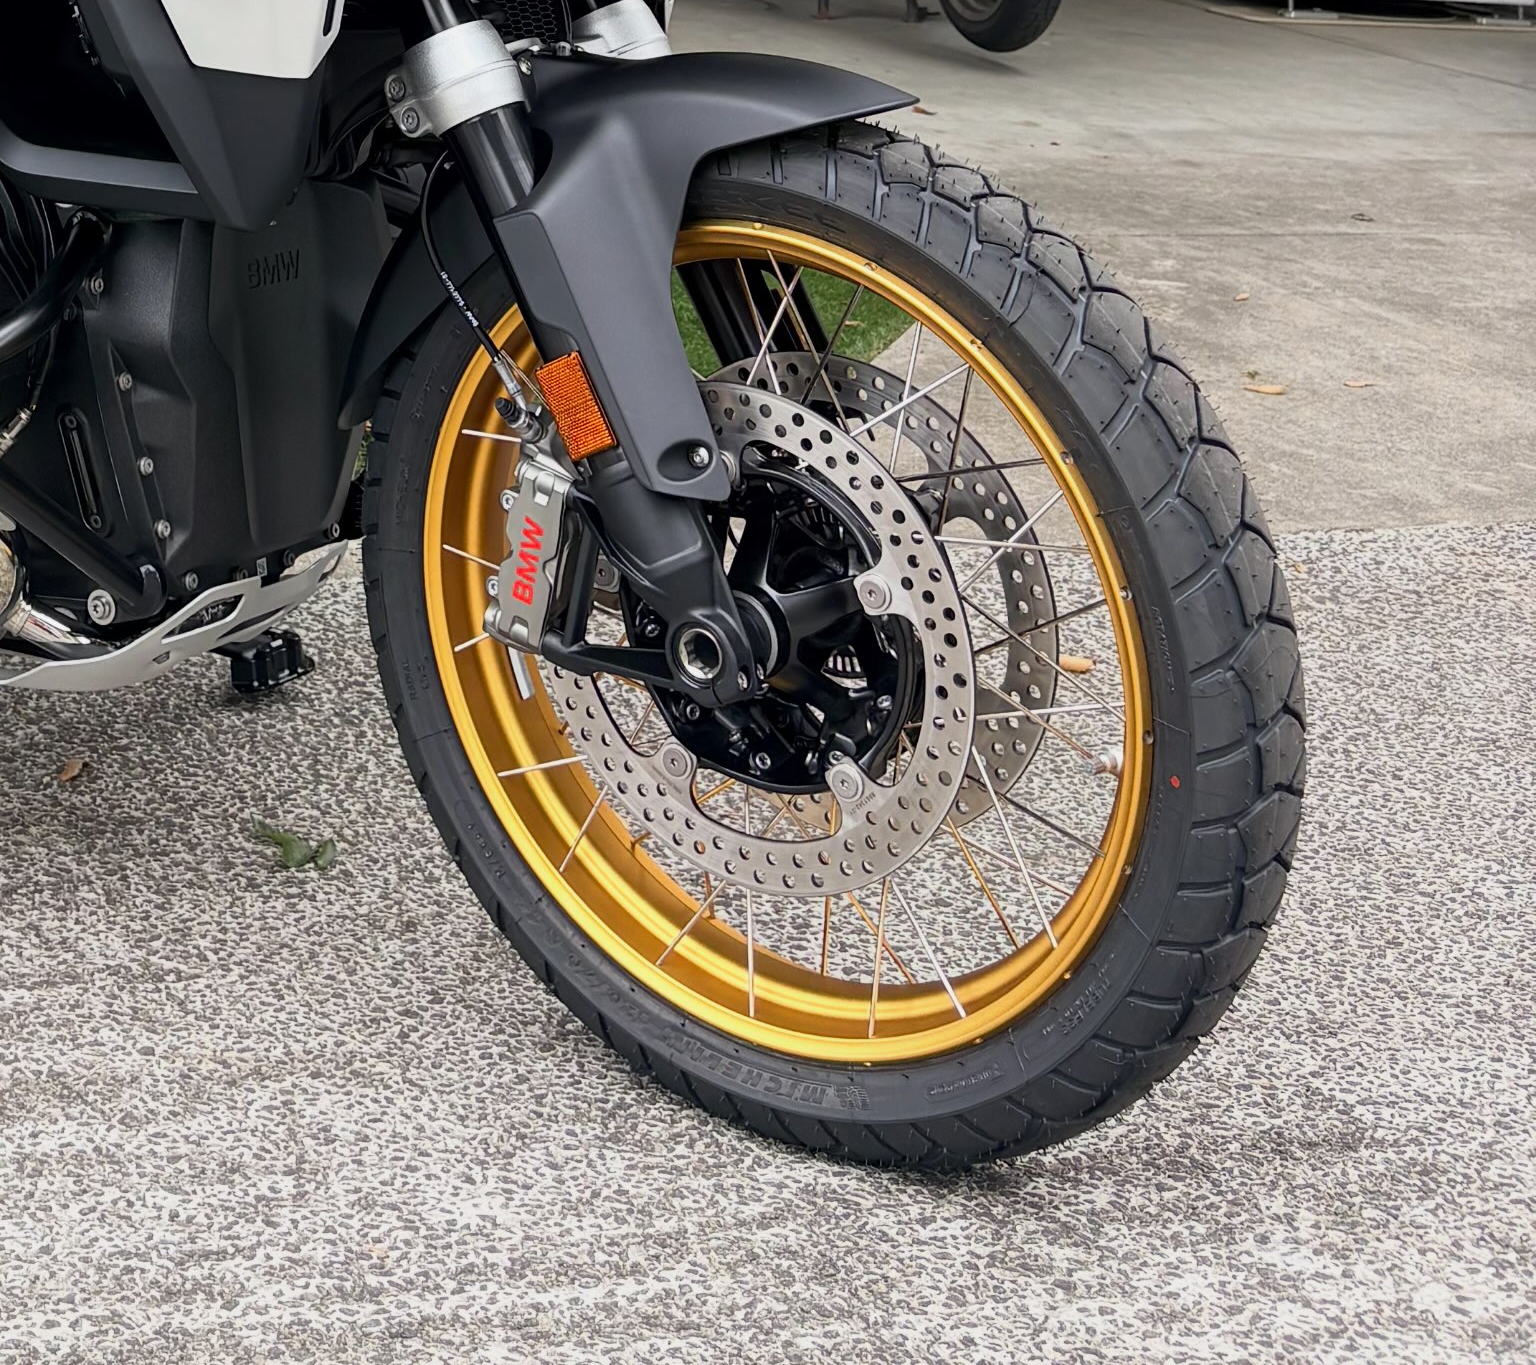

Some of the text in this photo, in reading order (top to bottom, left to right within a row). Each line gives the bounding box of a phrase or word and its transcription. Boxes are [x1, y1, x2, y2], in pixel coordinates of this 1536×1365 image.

[247, 248, 300, 290] BMW
[511, 515, 545, 605] BMW
[664, 1032, 829, 1107] MICHELIN
